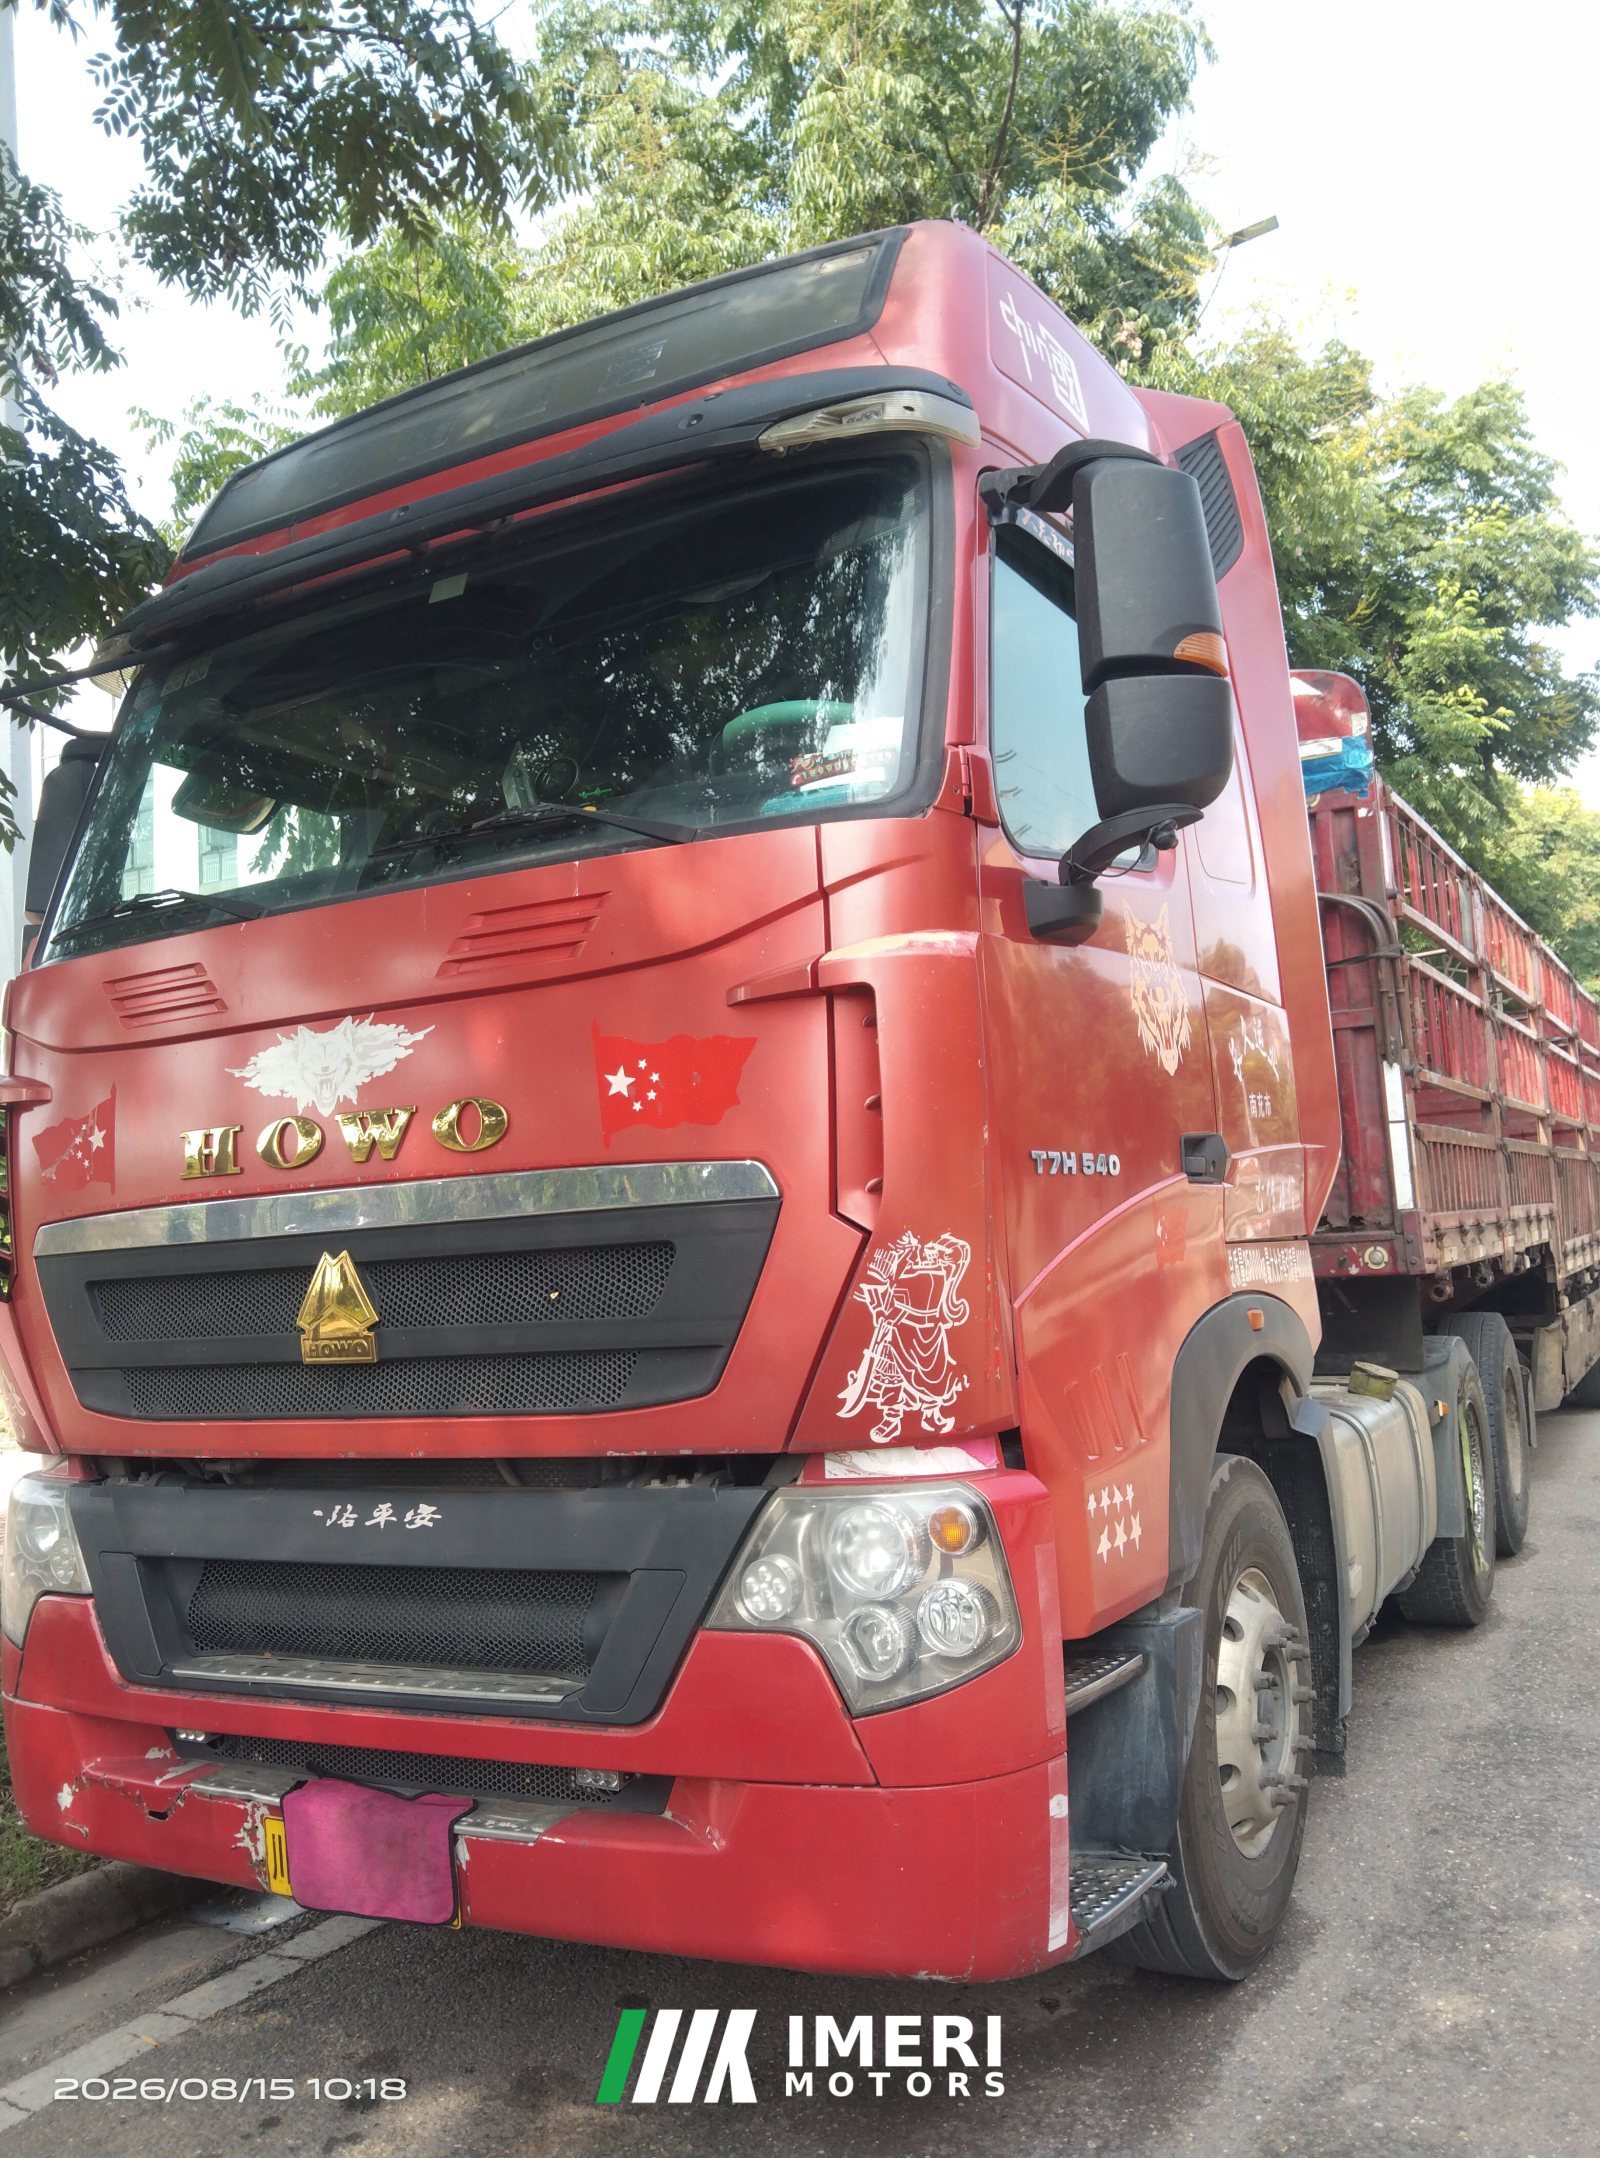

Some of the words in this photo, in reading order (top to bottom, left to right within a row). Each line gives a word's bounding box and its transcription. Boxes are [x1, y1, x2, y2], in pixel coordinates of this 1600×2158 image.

[180, 1097, 510, 1179] HOWO
[1030, 1150, 1077, 1175] T7H
[1081, 1152, 1121, 1177] 540
[305, 1338, 369, 1358] HOWO
[312, 1502, 443, 1530] 一路平安
